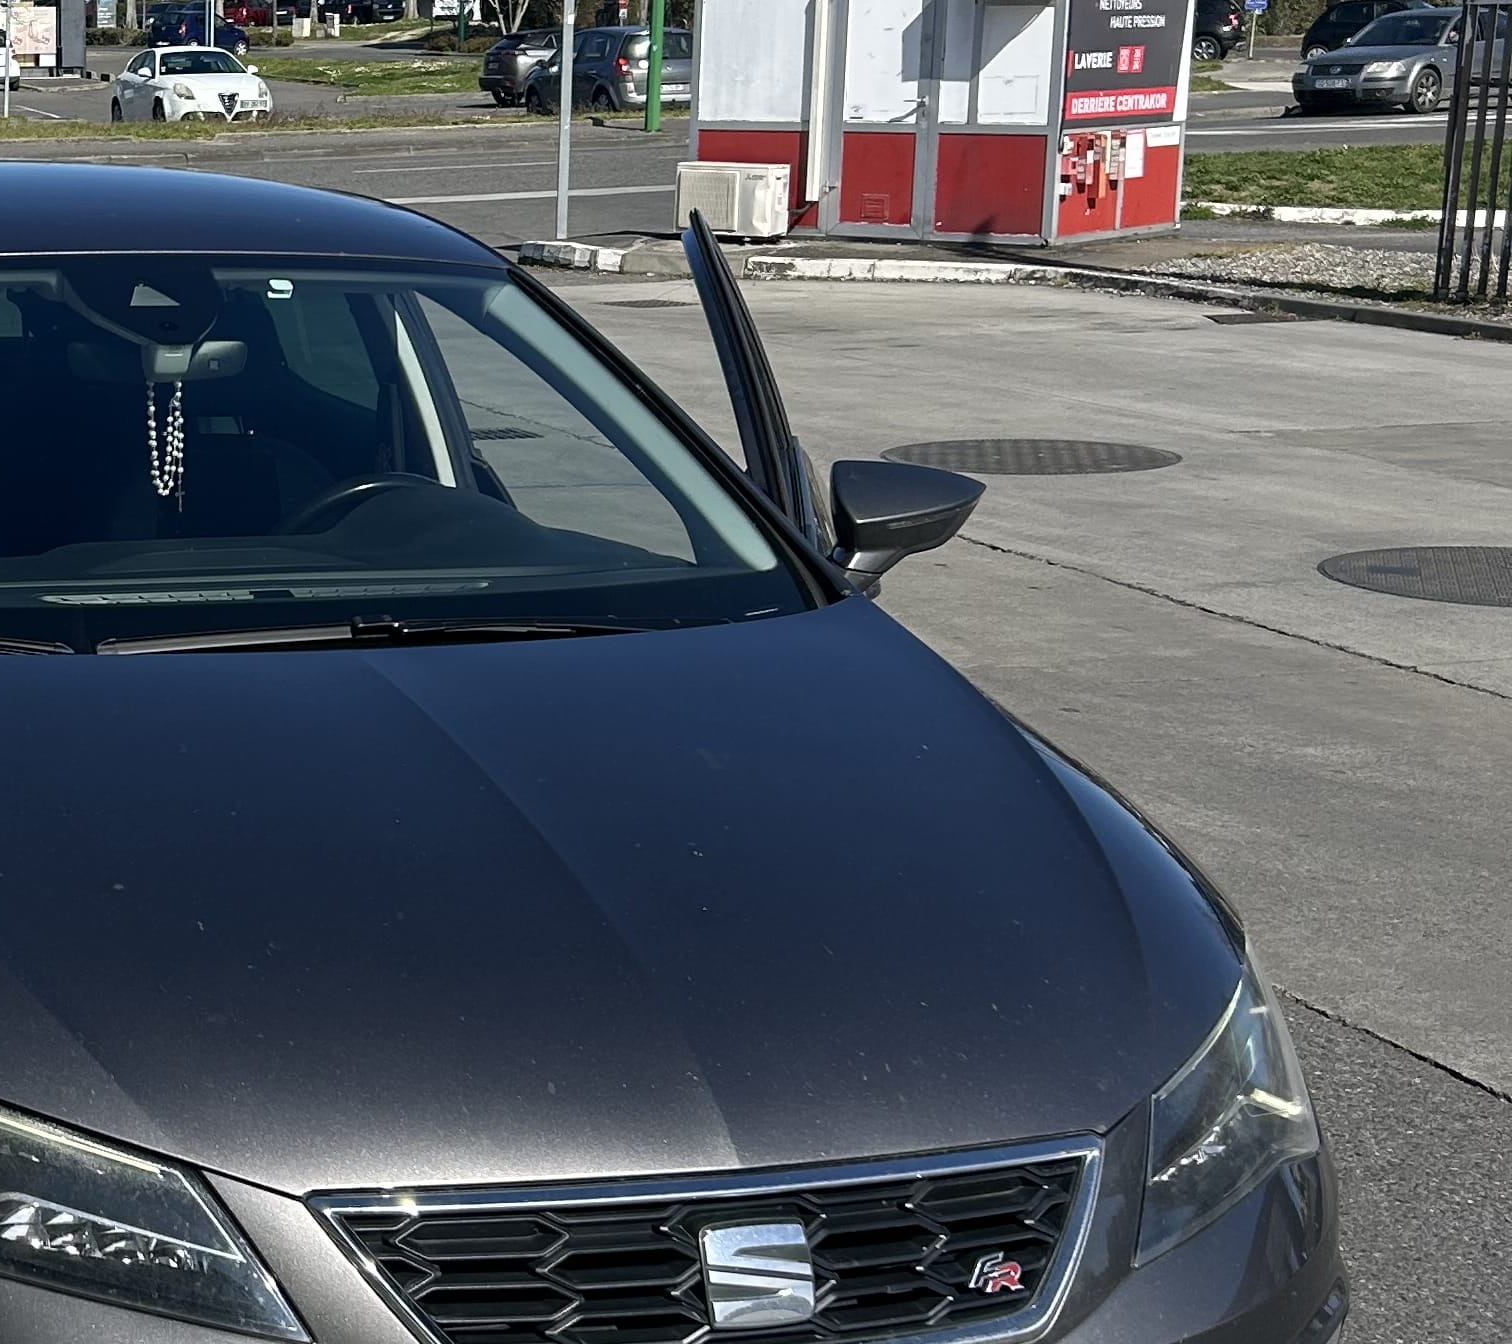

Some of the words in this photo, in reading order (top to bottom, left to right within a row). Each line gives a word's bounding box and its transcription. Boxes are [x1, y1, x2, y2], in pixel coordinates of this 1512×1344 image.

[1110, 15, 1133, 29] HAUTE
[1133, 14, 1166, 28] PRESSION
[1074, 51, 1113, 70] LAVERIE
[1071, 92, 1115, 115] DERRIÈRE
[1117, 93, 1167, 113] CENTRAKOR
